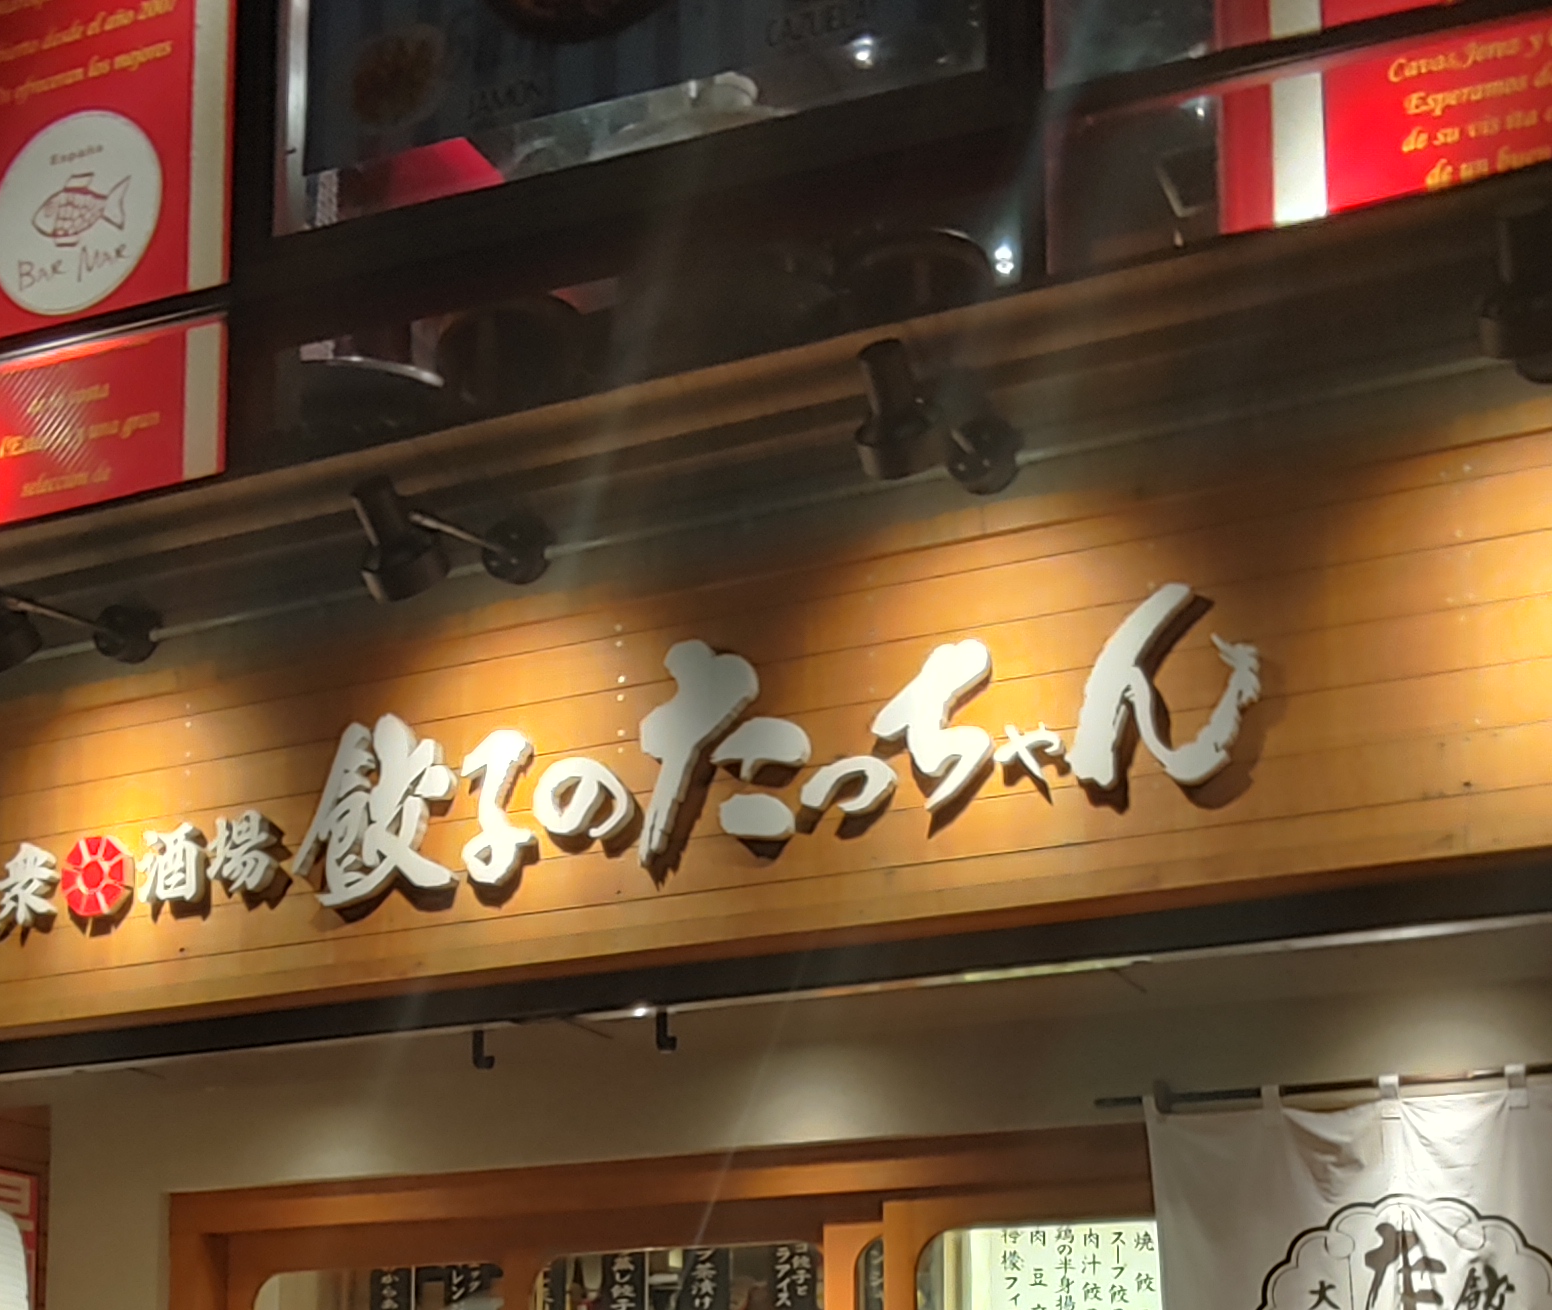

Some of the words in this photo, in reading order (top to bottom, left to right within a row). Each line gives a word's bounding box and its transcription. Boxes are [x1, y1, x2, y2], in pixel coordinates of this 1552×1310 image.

[1403, 75, 1529, 116] Esperamos
[1401, 126, 1430, 153] de
[1432, 126, 1460, 146] su
[293, 580, 1263, 908] 餃子のたっちゃん
